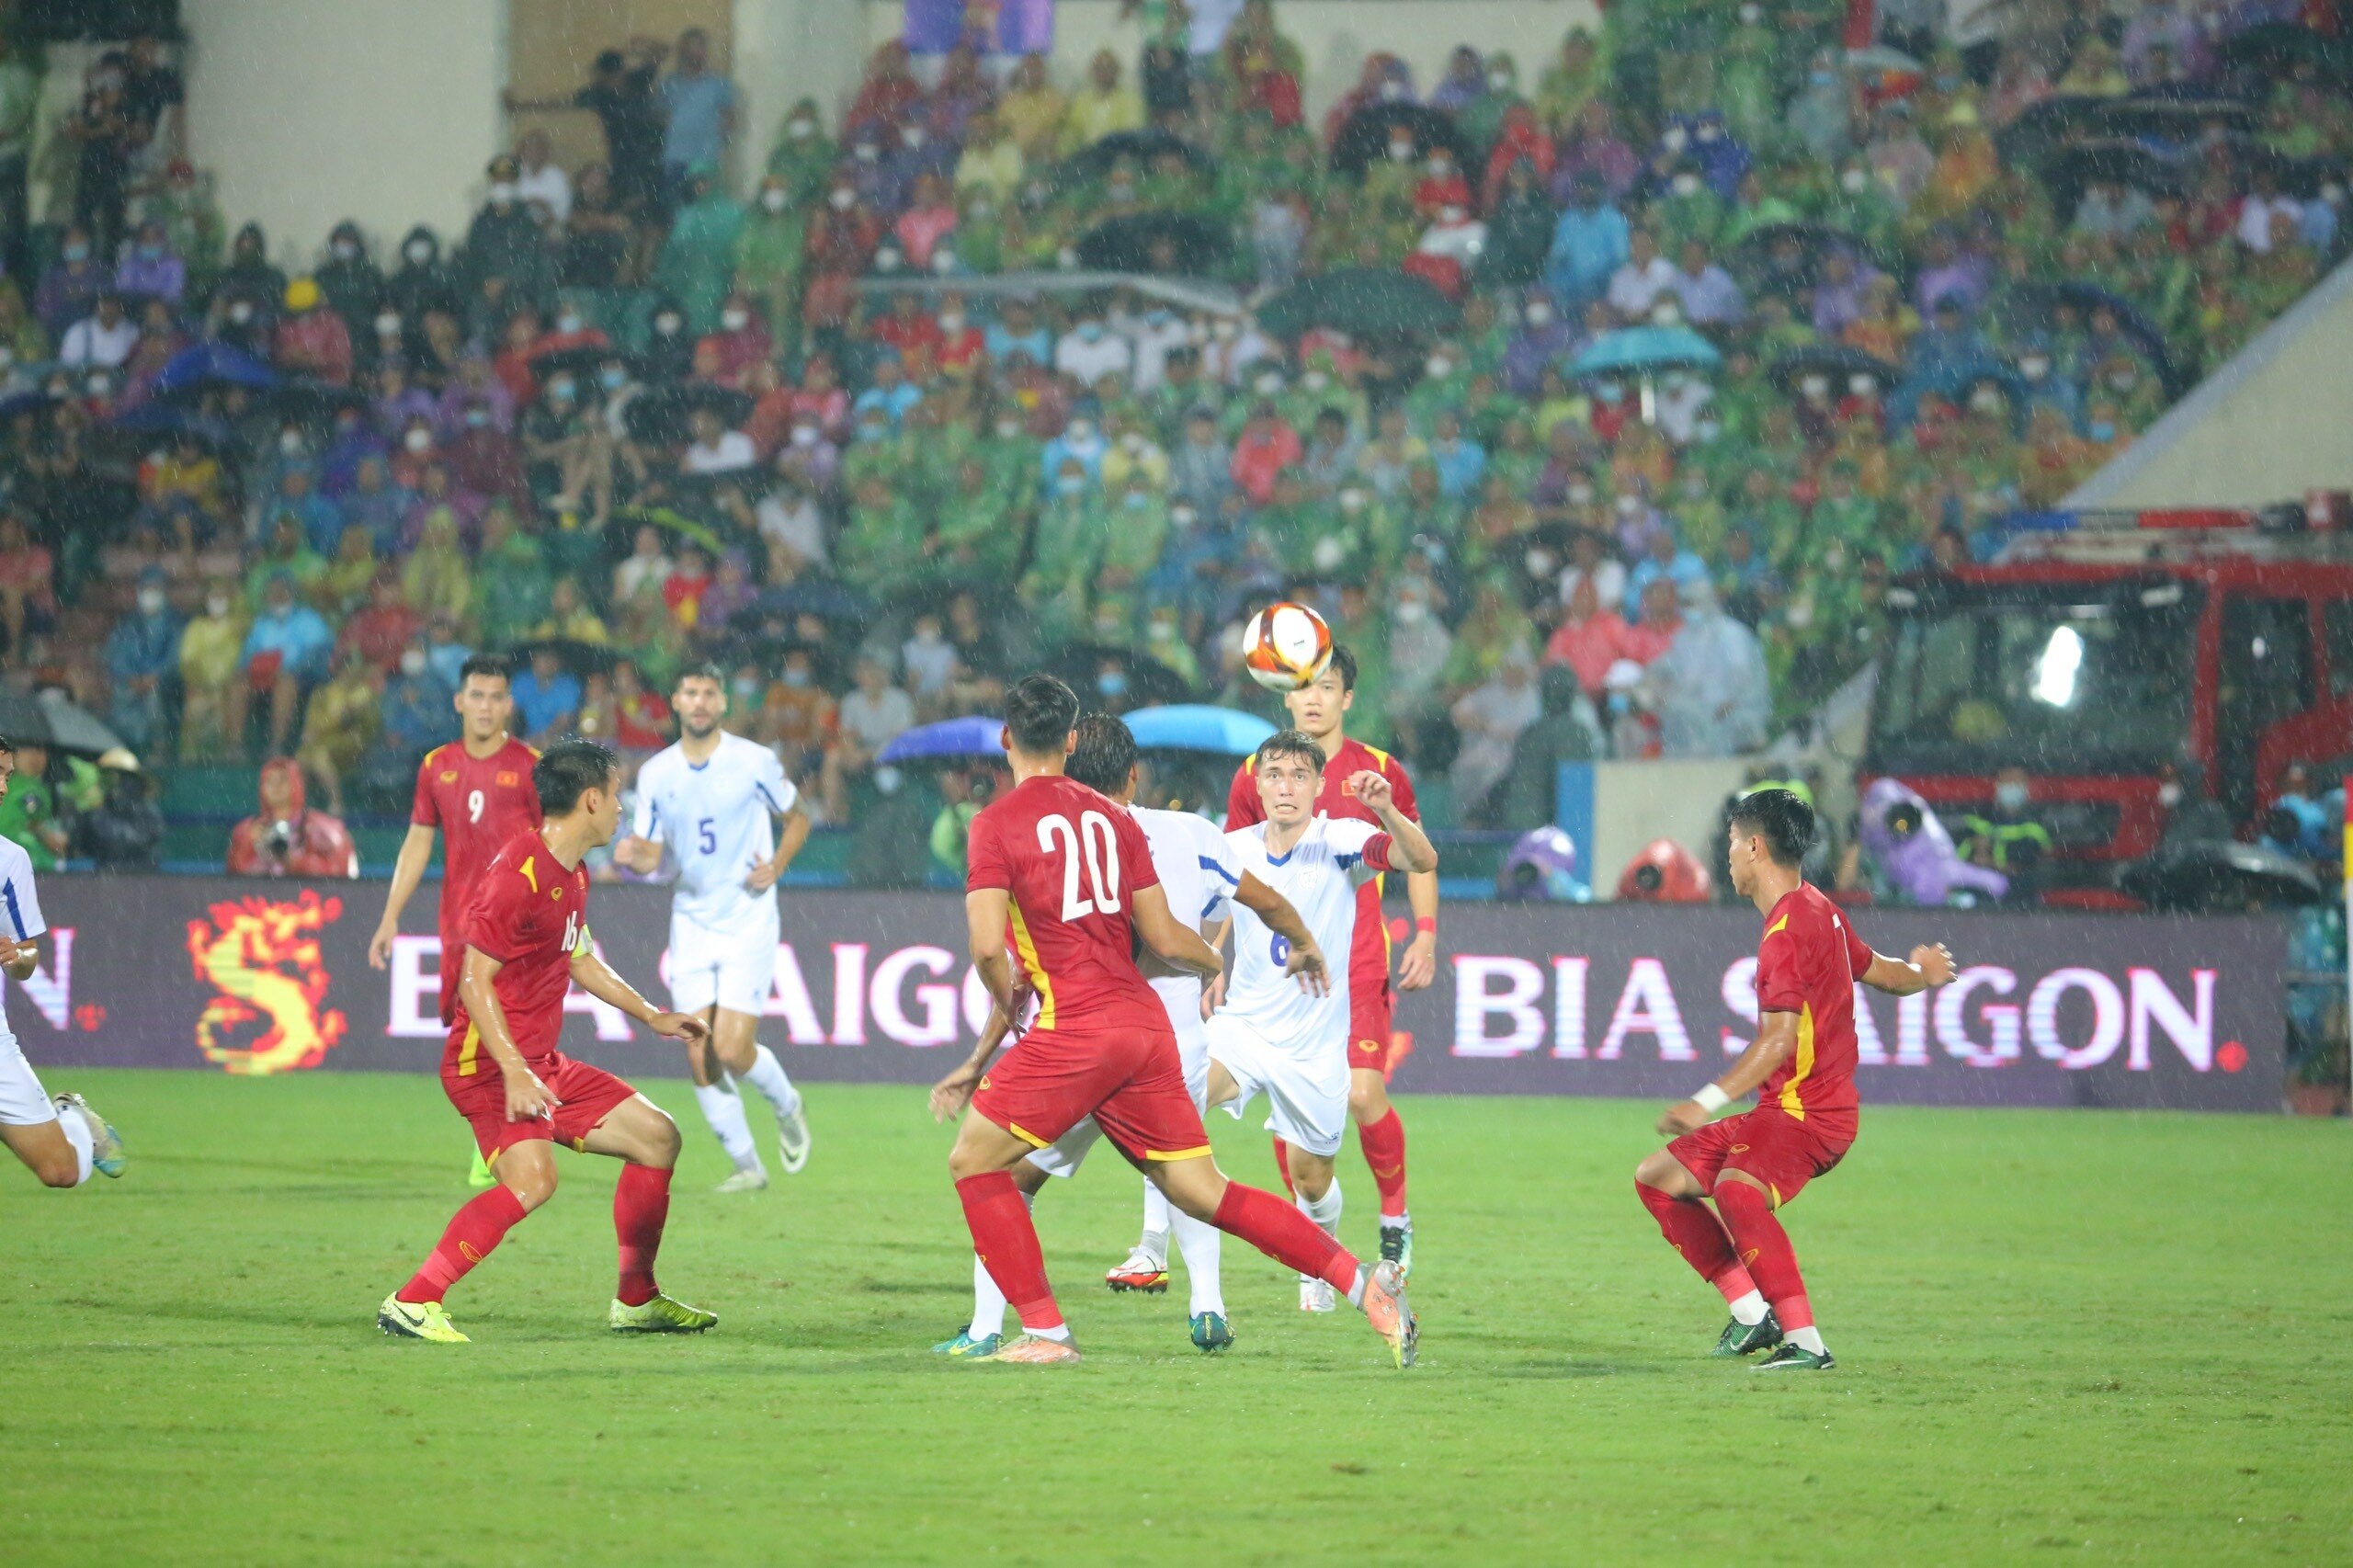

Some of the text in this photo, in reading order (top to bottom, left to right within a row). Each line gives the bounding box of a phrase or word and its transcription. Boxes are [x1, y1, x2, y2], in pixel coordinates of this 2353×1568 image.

[467, 789, 485, 825] 9
[699, 817, 717, 856] 5
[1035, 809, 1122, 924] 20
[560, 910, 579, 951] 16
[385, 934, 638, 1042] BA
[1449, 952, 1700, 1062] BIA
